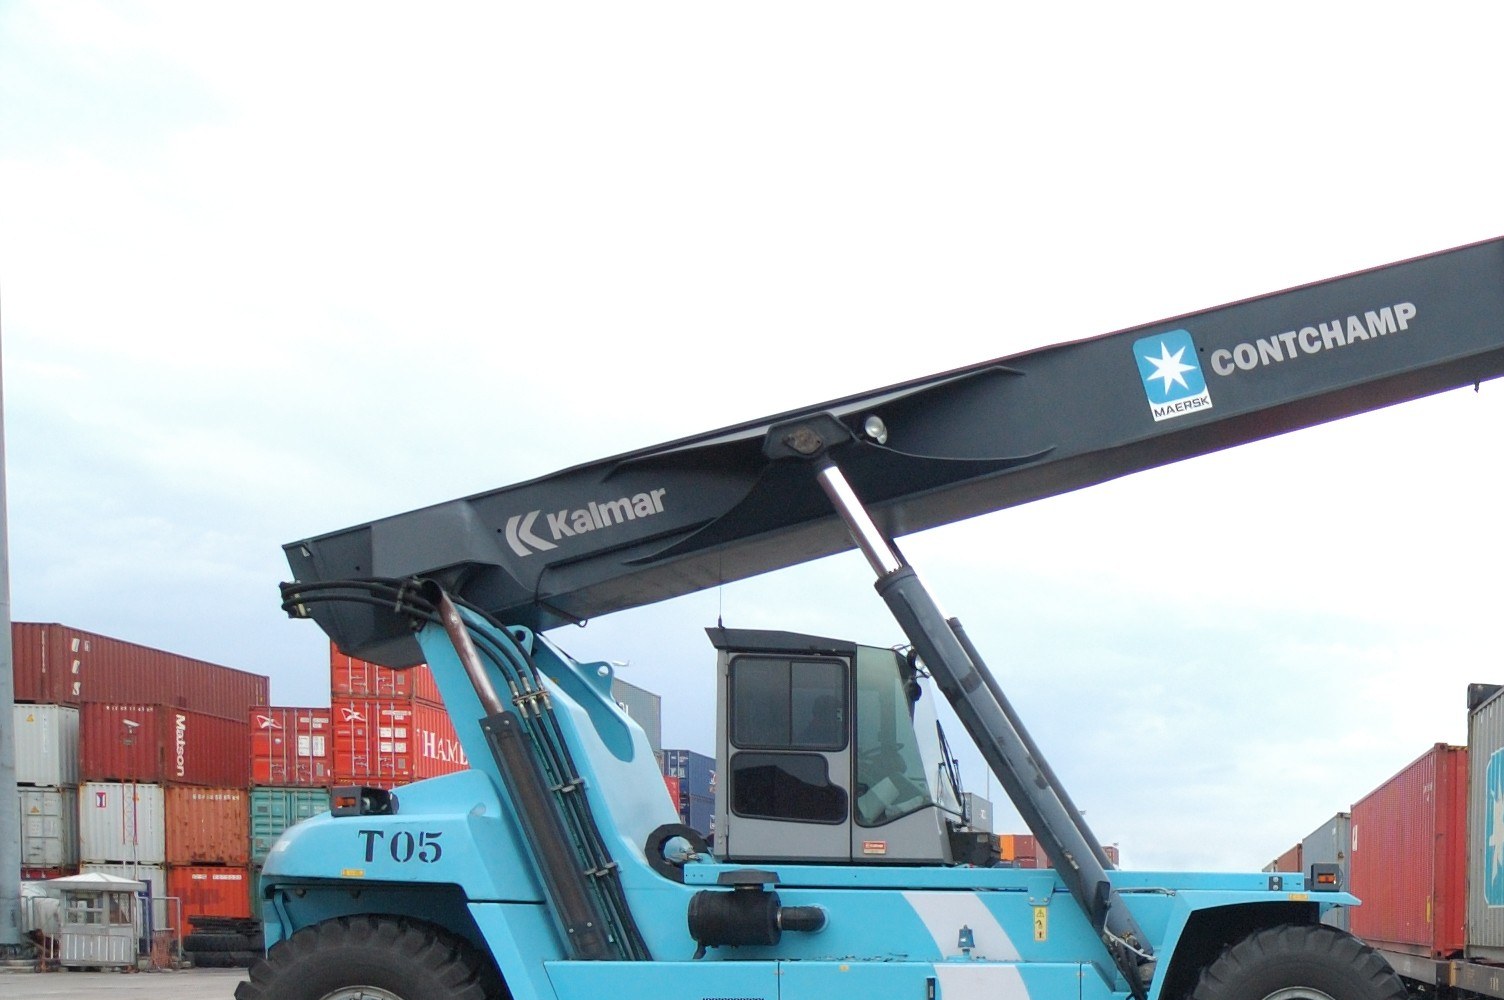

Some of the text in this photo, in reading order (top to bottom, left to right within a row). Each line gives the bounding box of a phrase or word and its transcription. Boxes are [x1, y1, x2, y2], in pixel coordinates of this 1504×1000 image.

[1211, 302, 1417, 376] CONTCHAMP
[1154, 396, 1209, 418] MAERSK
[547, 487, 666, 540] Kalmar
[175, 714, 186, 777] Matson
